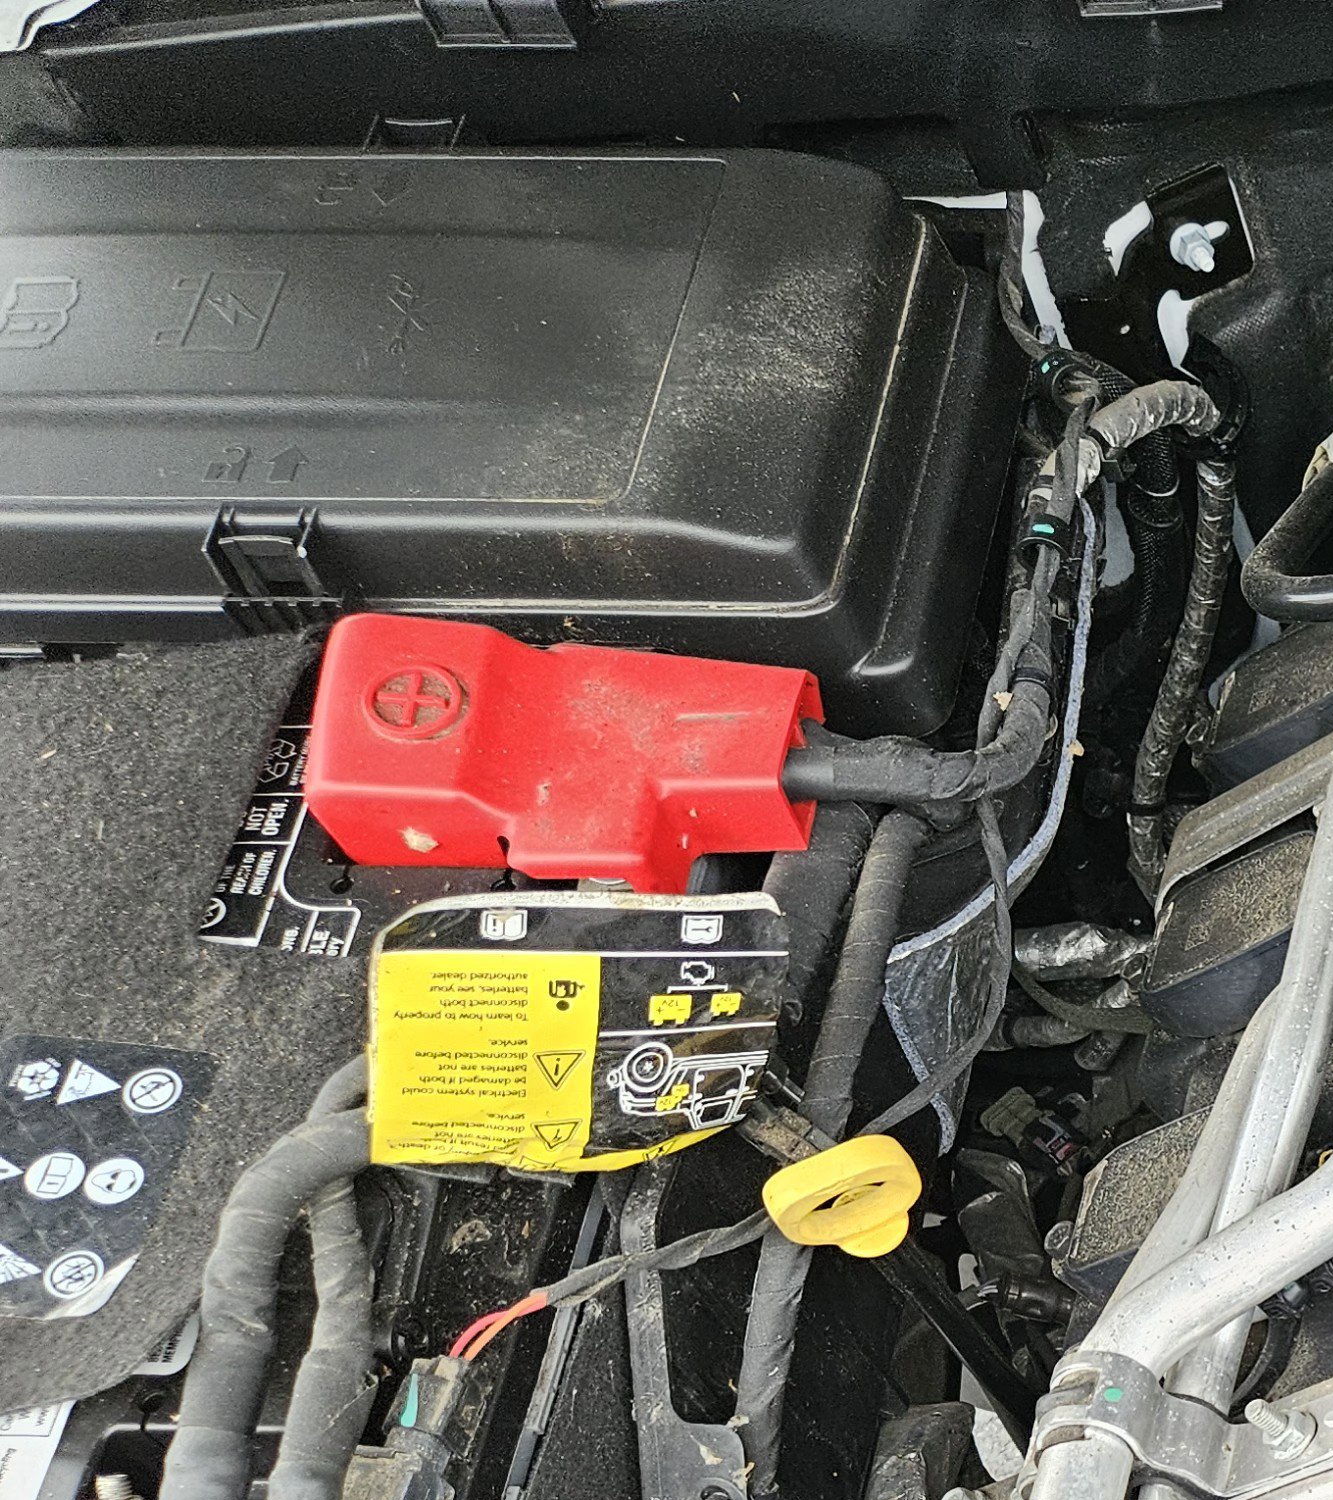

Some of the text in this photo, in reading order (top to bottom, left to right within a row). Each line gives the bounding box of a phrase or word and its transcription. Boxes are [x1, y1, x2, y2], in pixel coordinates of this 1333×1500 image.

[245, 806, 268, 831] NOT
[261, 798, 290, 837] OPEN.
[247, 848, 278, 896] CHILDREN.
[431, 972, 528, 981] authorized dealer.
[429, 984, 456, 993] your
[479, 985, 528, 994] batteries,
[439, 999, 528, 1007] disconnect both
[393, 1010, 529, 1021] To learn how to properly
[488, 1038, 528, 1046] service.
[415, 1051, 528, 1060] disconnected before
[480, 1064, 527, 1072] batteries
[419, 1075, 527, 1085] be damaged if both
[401, 1087, 527, 1098] Electrical system could
[411, 1120, 525, 1133] disconnected before
